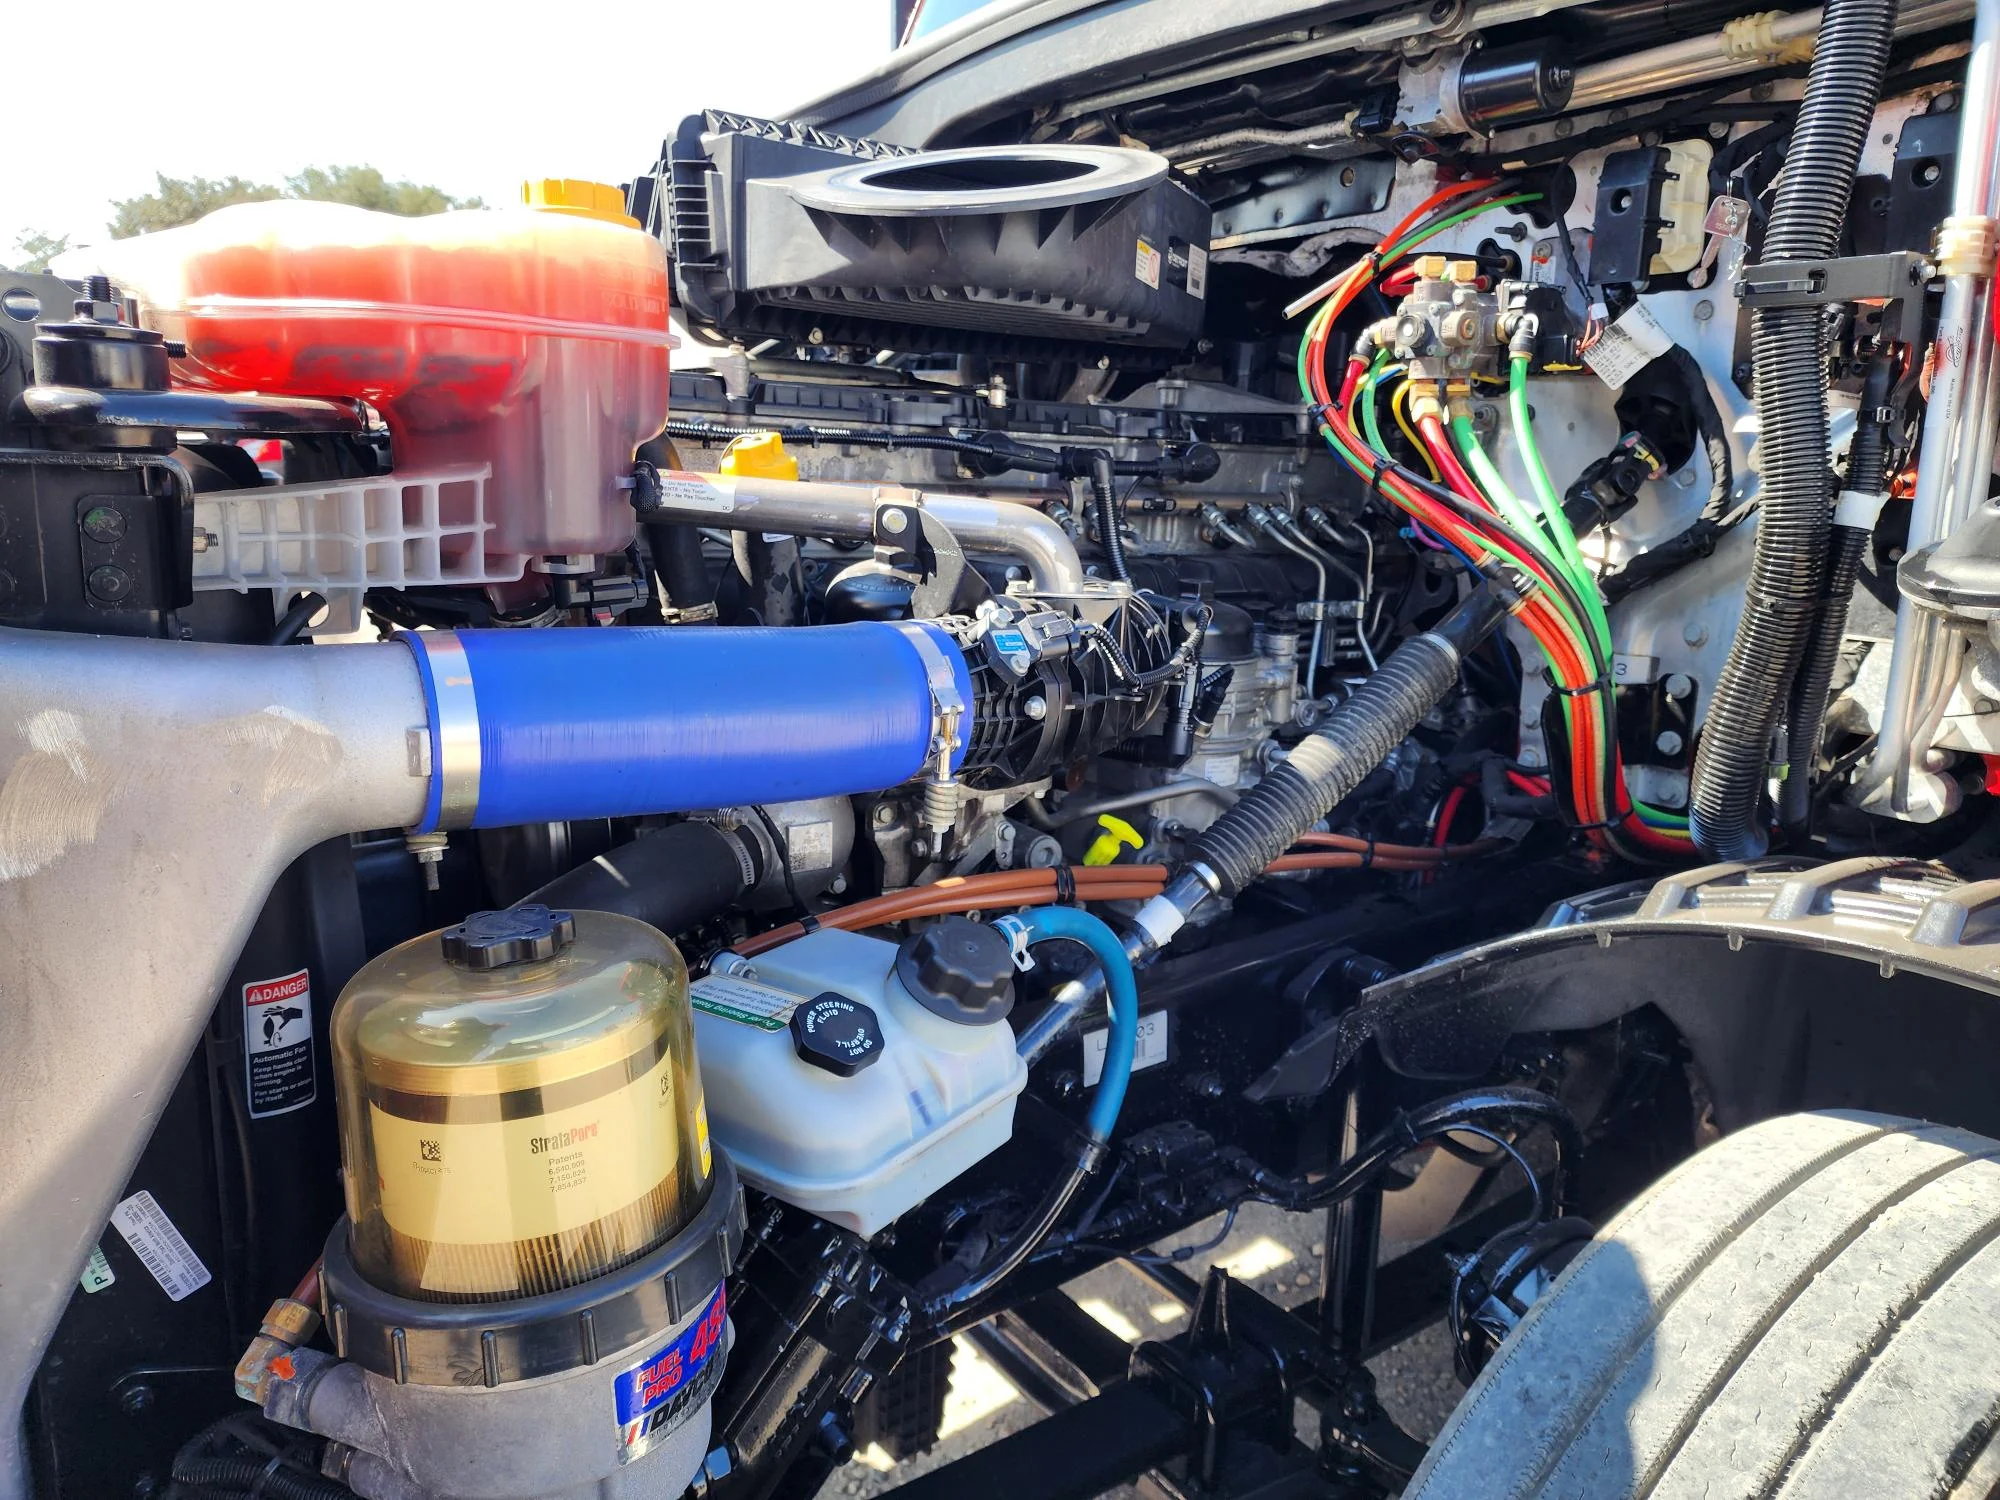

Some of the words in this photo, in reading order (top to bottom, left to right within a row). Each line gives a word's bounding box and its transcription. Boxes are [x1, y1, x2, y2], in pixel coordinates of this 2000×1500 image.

[263, 978, 307, 1000] DANGER
[713, 1004, 749, 1019] Steering
[806, 1010, 817, 1033] POWER
[815, 1001, 855, 1013] STEERING
[817, 1009, 839, 1024] FLUID
[835, 1028, 865, 1049] OVERFILL
[863, 1039, 873, 1049] DO
[253, 1050, 294, 1064] Automatic
[294, 1046, 306, 1055] Fan
[849, 1046, 864, 1056] NOT
[253, 1066, 272, 1074] Keep
[273, 1061, 293, 1070] hands
[273, 1067, 296, 1077] engine
[268, 1086, 289, 1094] starts
[530, 1123, 598, 1154] StrataPore
[548, 1151, 583, 1166] Patents
[637, 1348, 684, 1391] FUEL
[642, 1365, 683, 1409] PRO
